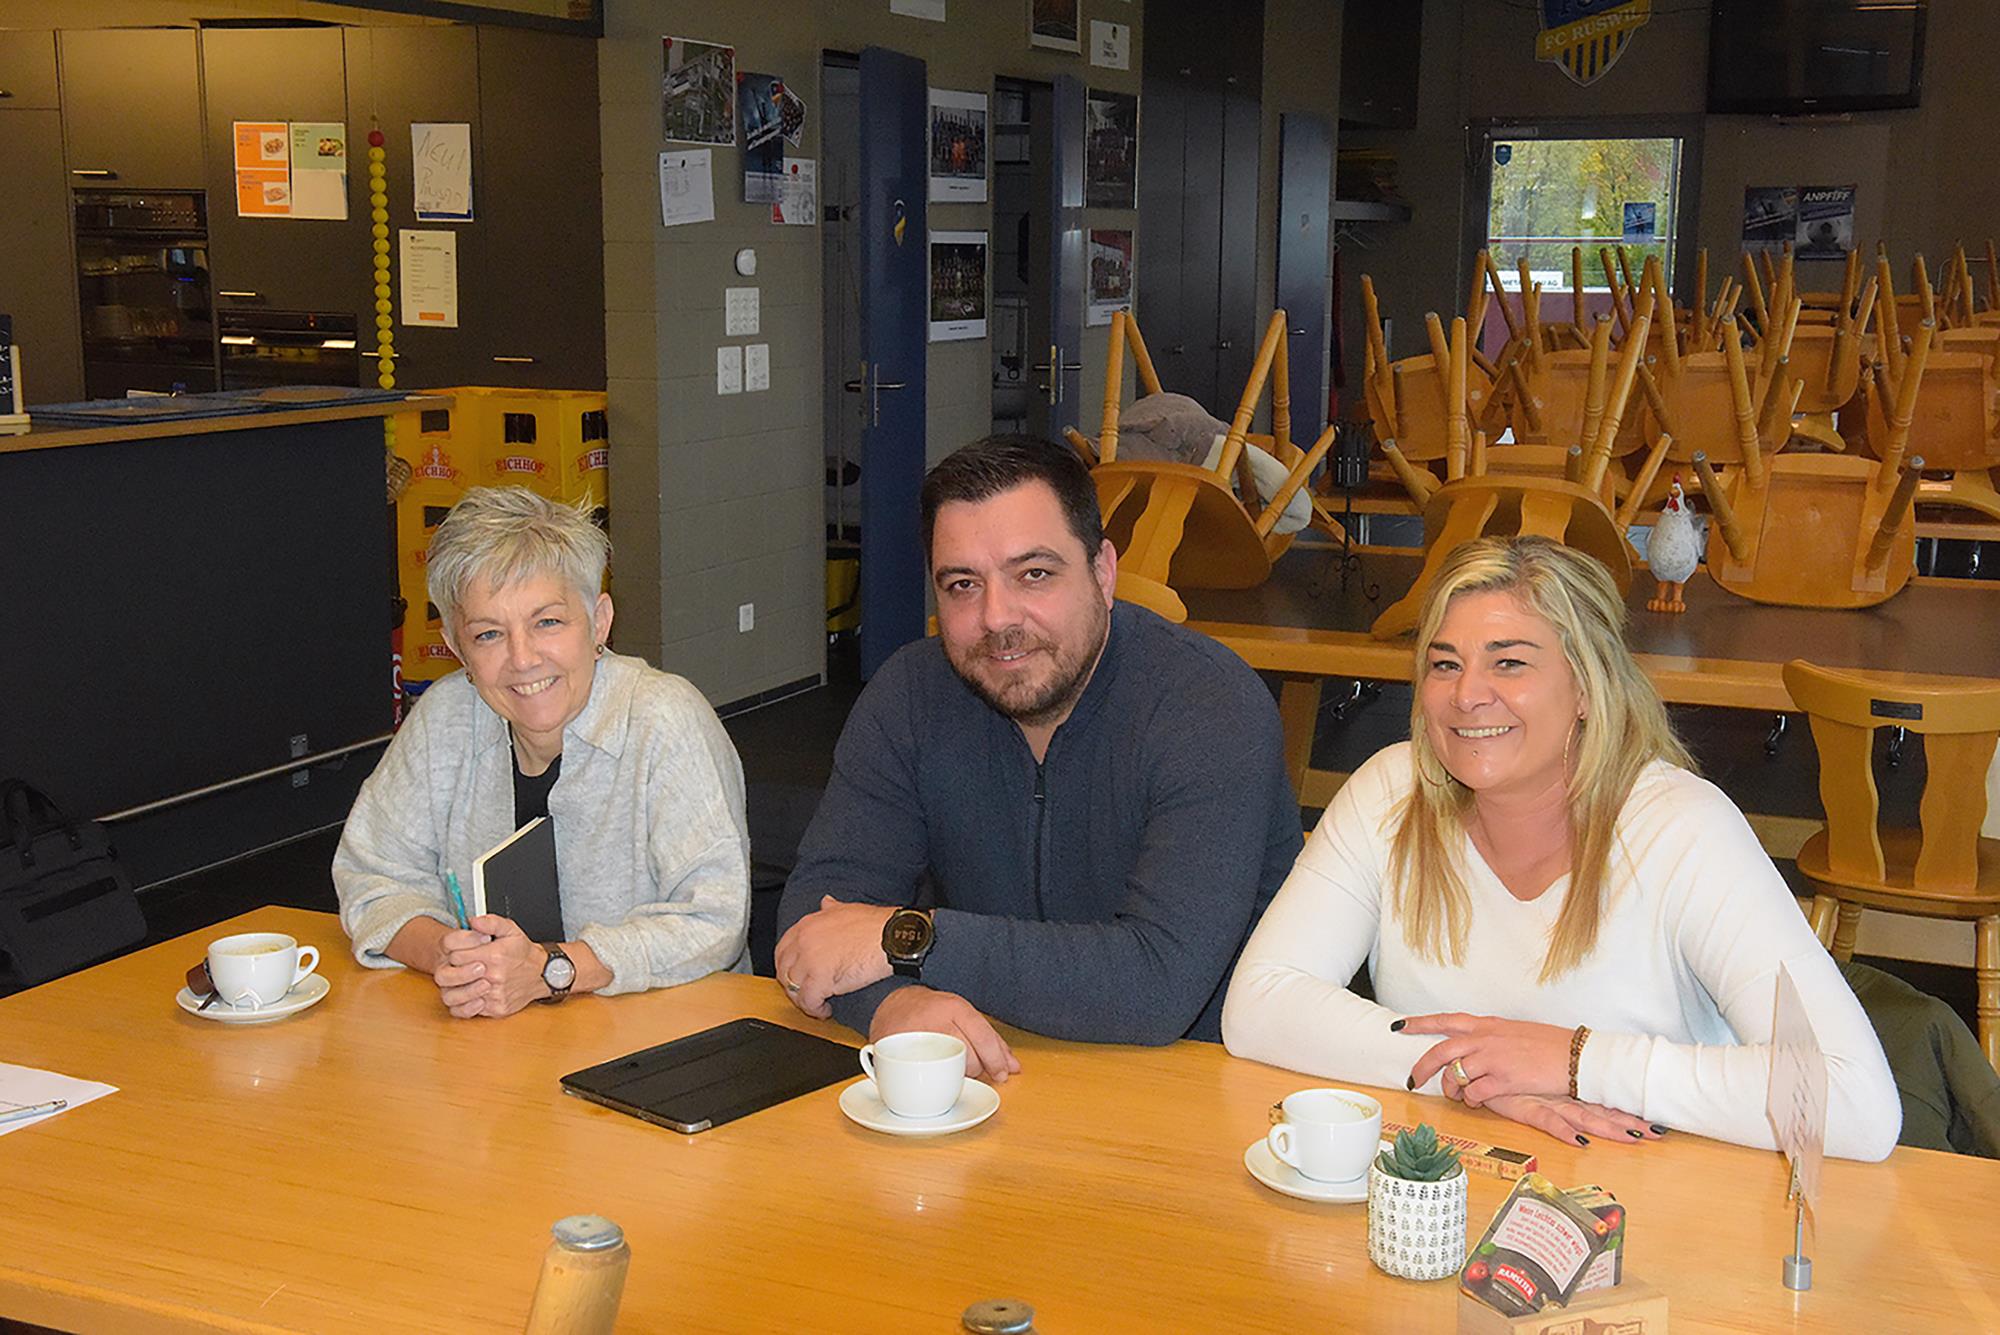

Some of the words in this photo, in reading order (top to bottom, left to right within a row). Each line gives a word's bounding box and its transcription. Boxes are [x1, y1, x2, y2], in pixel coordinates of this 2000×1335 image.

[1545, 32, 1567, 50] FC
[1572, 7, 1640, 40] RUSWIL
[1803, 190, 1850, 202] ANPFIFF
[496, 457, 545, 473] EICHHOF
[577, 449, 608, 472] EICHH
[415, 465, 458, 479] EICHHOF
